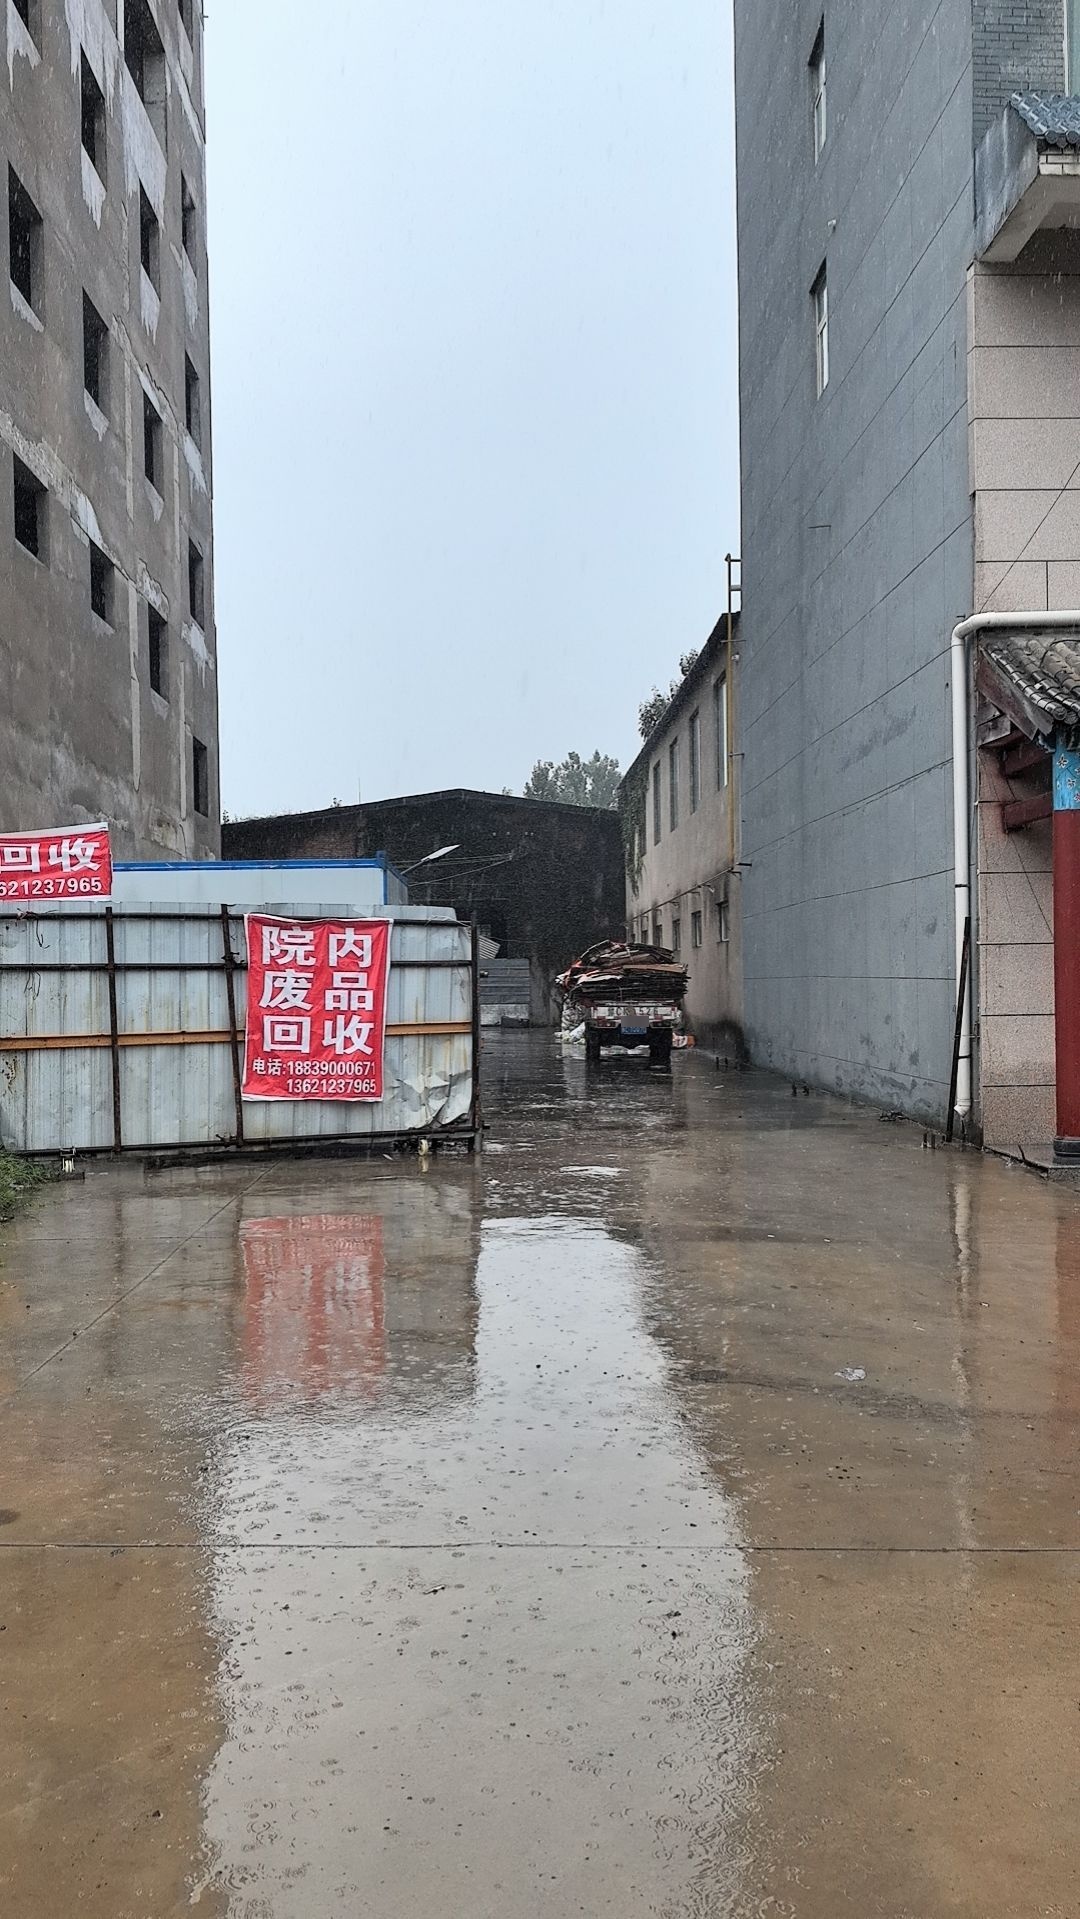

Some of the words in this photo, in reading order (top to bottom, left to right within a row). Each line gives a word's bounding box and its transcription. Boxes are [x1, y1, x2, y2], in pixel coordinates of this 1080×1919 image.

[0, 837, 101, 873] 回收
[0, 876, 102, 897] 621237965
[261, 925, 372, 968] 院内
[258, 968, 374, 1011] 废品
[262, 1014, 375, 1056] 回收
[286, 1078, 376, 1094] 13621237965
